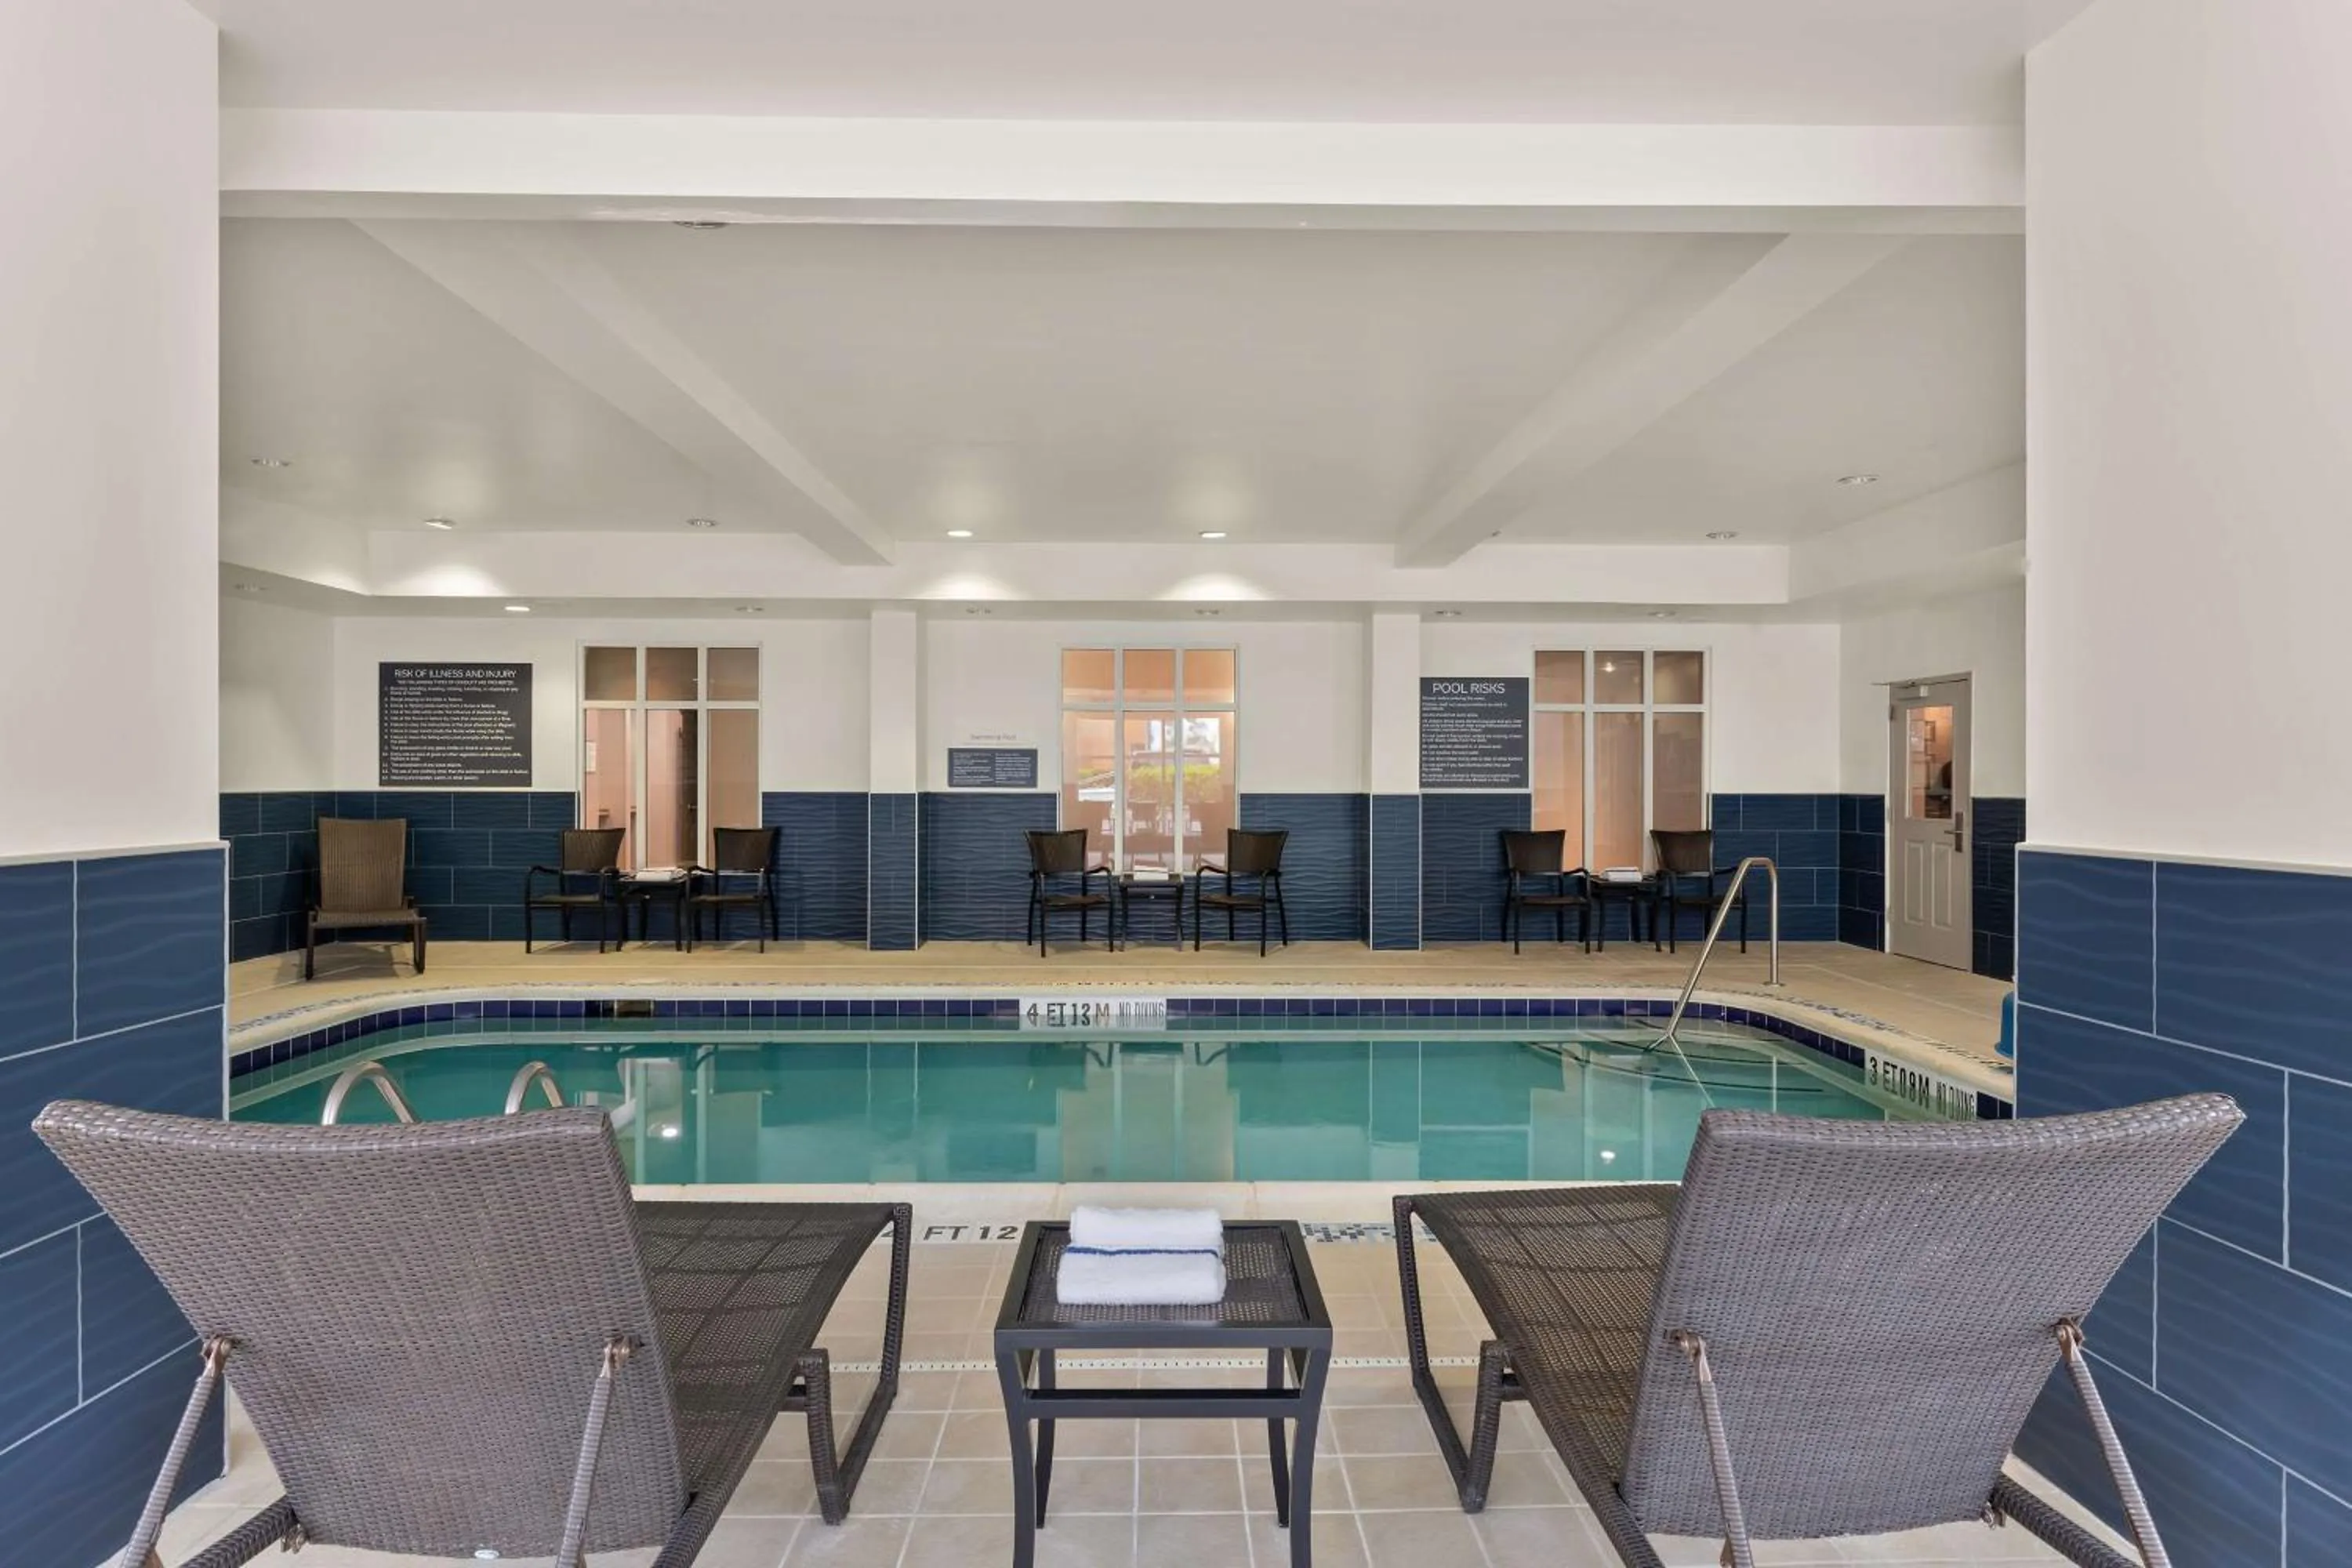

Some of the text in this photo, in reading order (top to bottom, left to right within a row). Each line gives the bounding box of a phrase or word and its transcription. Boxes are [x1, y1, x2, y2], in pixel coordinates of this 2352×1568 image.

[394, 669, 517, 678] RISK OF ILLNESS AND INJURY
[1432, 683, 1506, 694] POOL RISKS
[924, 1225, 968, 1240] FT
